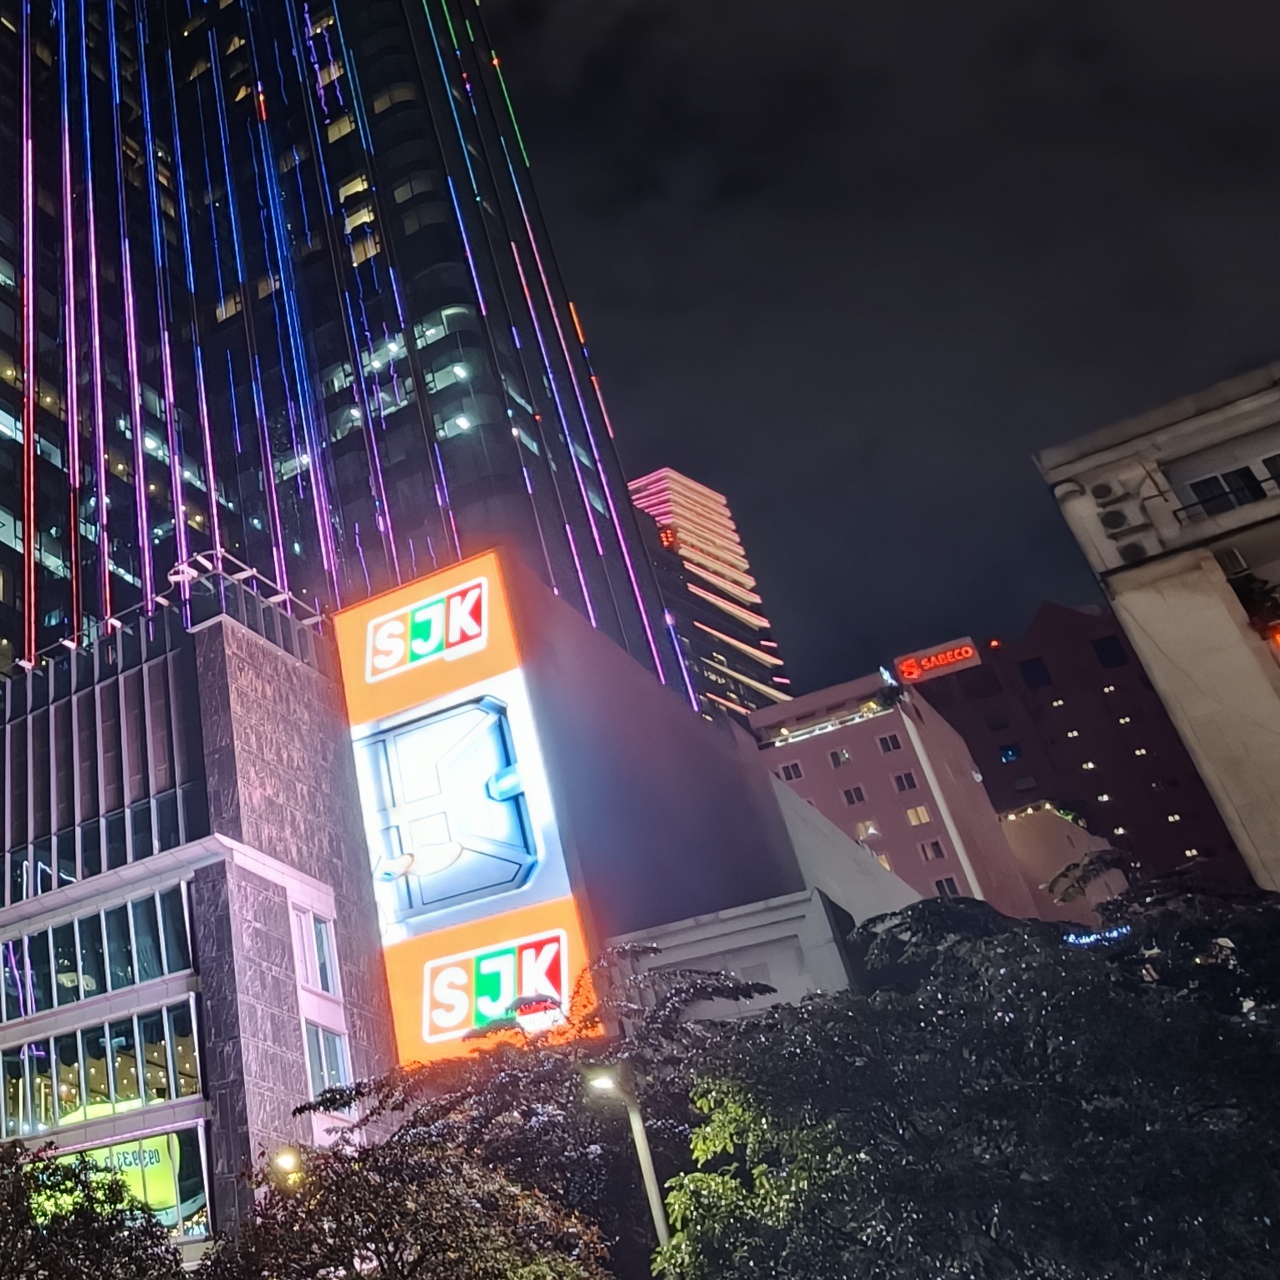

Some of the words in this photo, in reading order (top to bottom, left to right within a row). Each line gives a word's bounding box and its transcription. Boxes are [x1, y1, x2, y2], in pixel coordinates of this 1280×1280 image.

[373, 587, 481, 670] SJK
[921, 646, 974, 670] SABECO
[431, 942, 560, 1028] SJK
